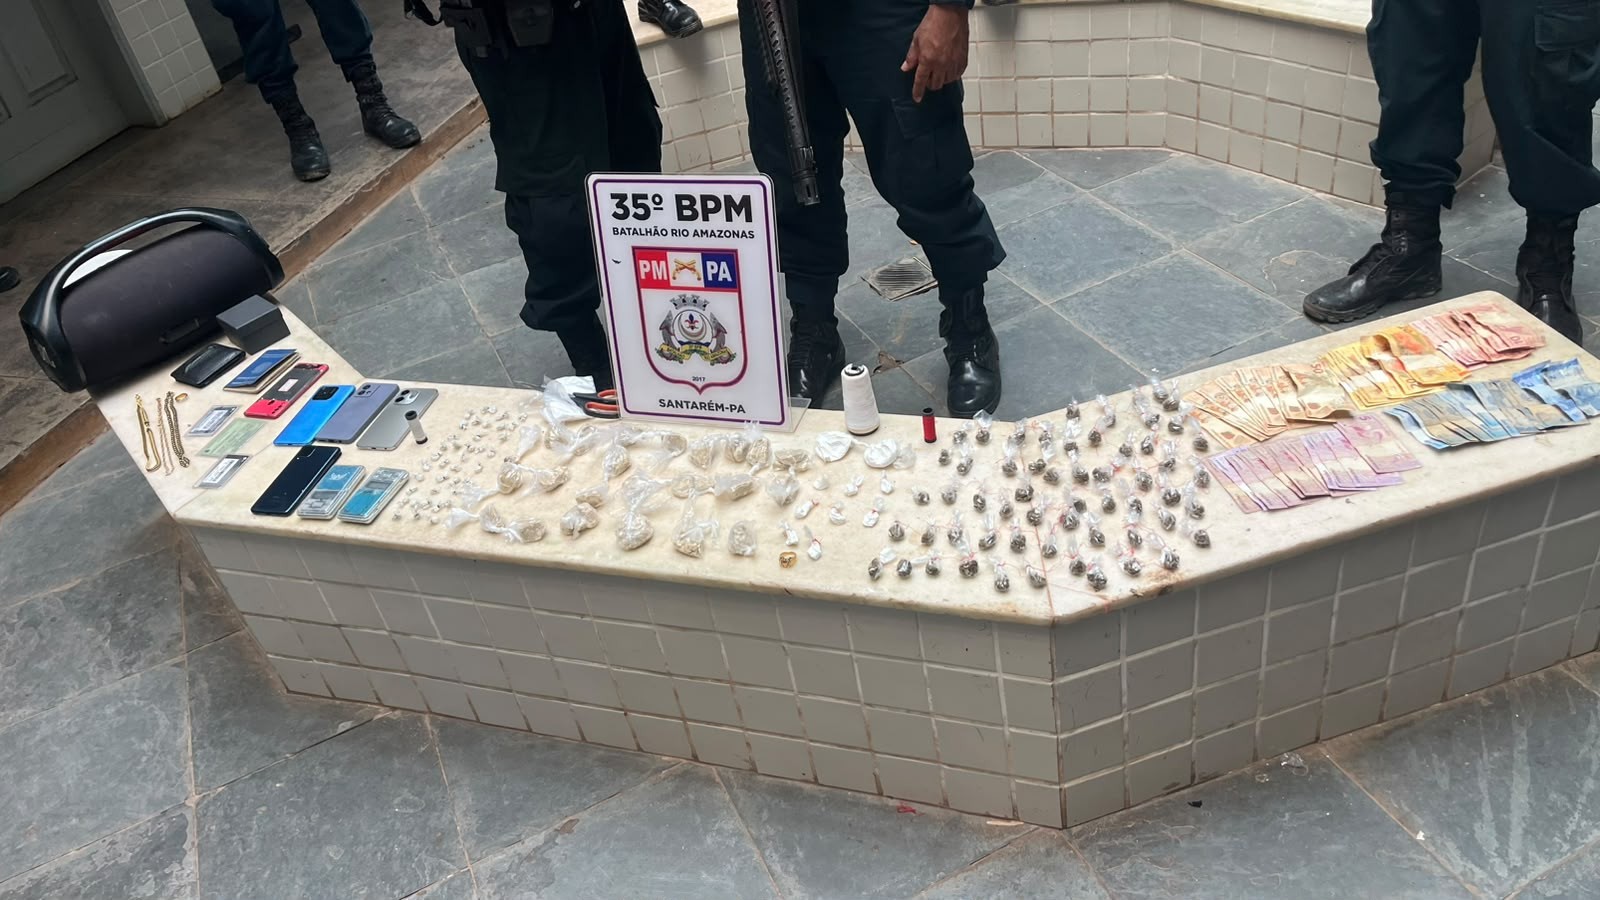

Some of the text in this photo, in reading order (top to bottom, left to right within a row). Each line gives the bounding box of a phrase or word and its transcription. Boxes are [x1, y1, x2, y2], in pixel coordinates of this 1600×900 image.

[610, 193, 753, 222] 35º BPM
[612, 226, 755, 239] BATALHÃO RIO AMAZONAS
[639, 260, 667, 280] PM
[706, 261, 732, 282] PA
[1310, 363, 1323, 374] 50
[1406, 378, 1420, 389] 20
[659, 399, 746, 414] SANTARÉM-PA
